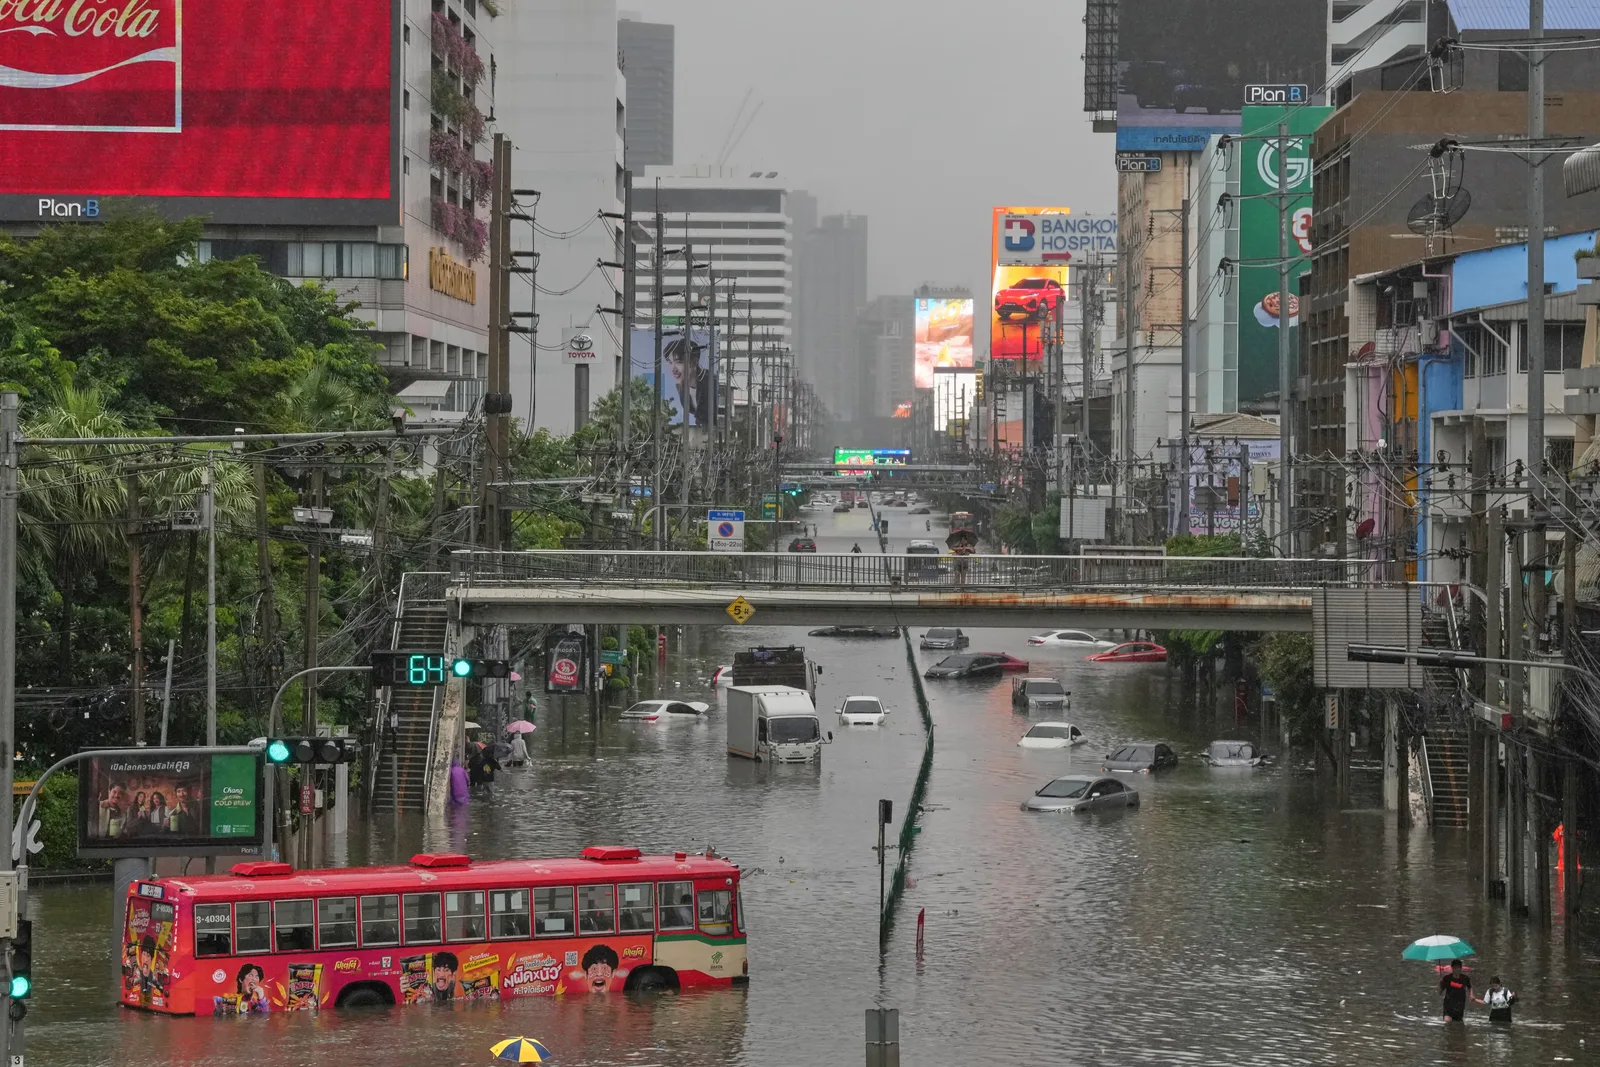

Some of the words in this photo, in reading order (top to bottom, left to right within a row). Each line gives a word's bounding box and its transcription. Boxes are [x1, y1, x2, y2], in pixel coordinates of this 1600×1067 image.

[1251, 88, 1285, 102] Plan
[1119, 160, 1147, 171] Plan
[38, 198, 81, 216] Plan
[733, 605, 741, 615] 5
[410, 655, 443, 683] 64
[196, 914, 231, 924] 3-40304
[14, 1055, 21, 1065] 3
